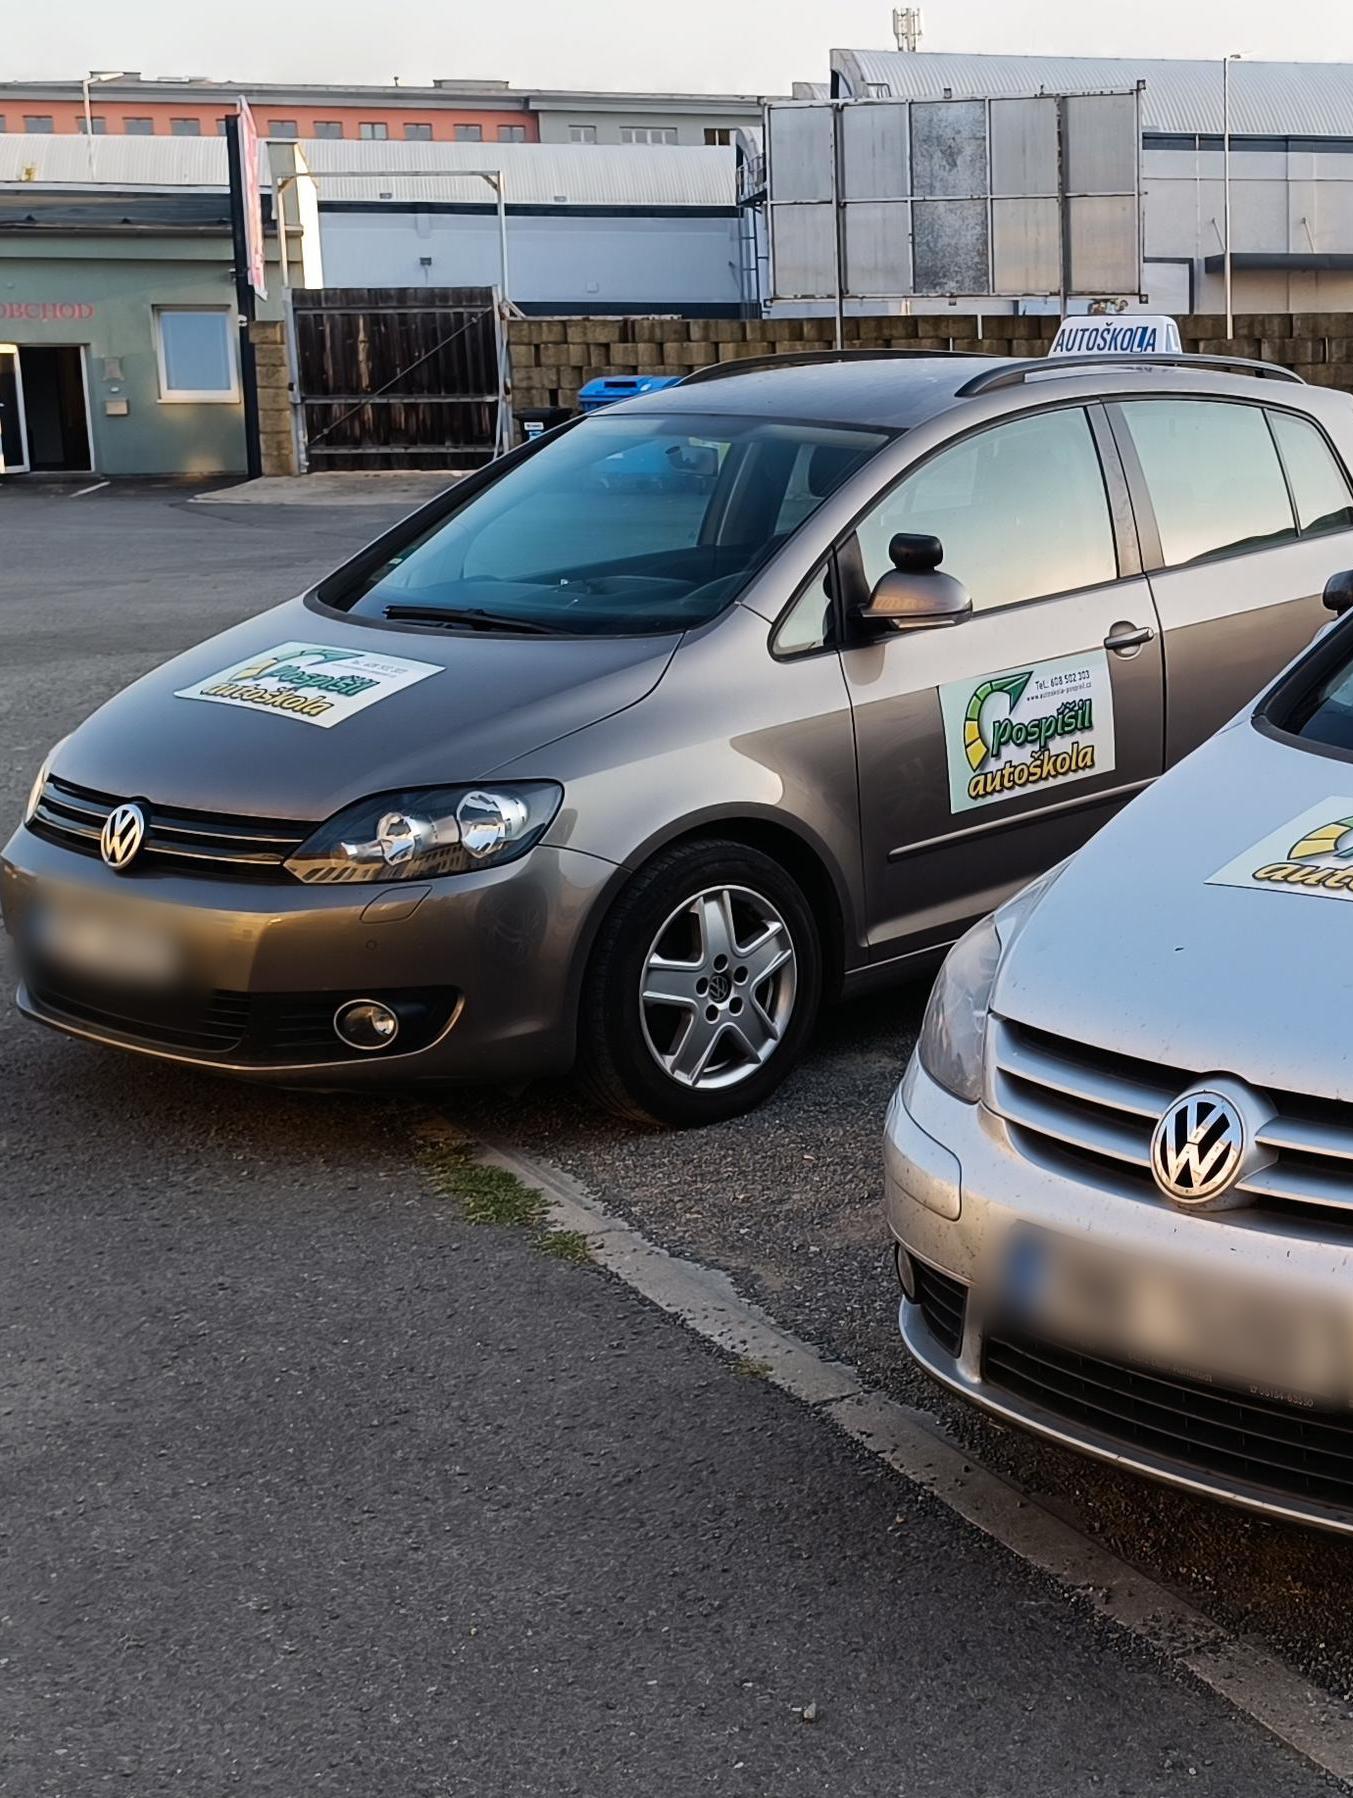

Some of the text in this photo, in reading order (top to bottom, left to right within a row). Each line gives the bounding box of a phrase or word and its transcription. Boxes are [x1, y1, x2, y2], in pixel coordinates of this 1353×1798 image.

[1053, 322, 1157, 353] AUTOŠKOLA
[1050, 676, 1063, 687] 608
[1064, 673, 1076, 684] 502
[200, 682, 335, 718] autoškola
[968, 742, 1095, 799] autoškola
